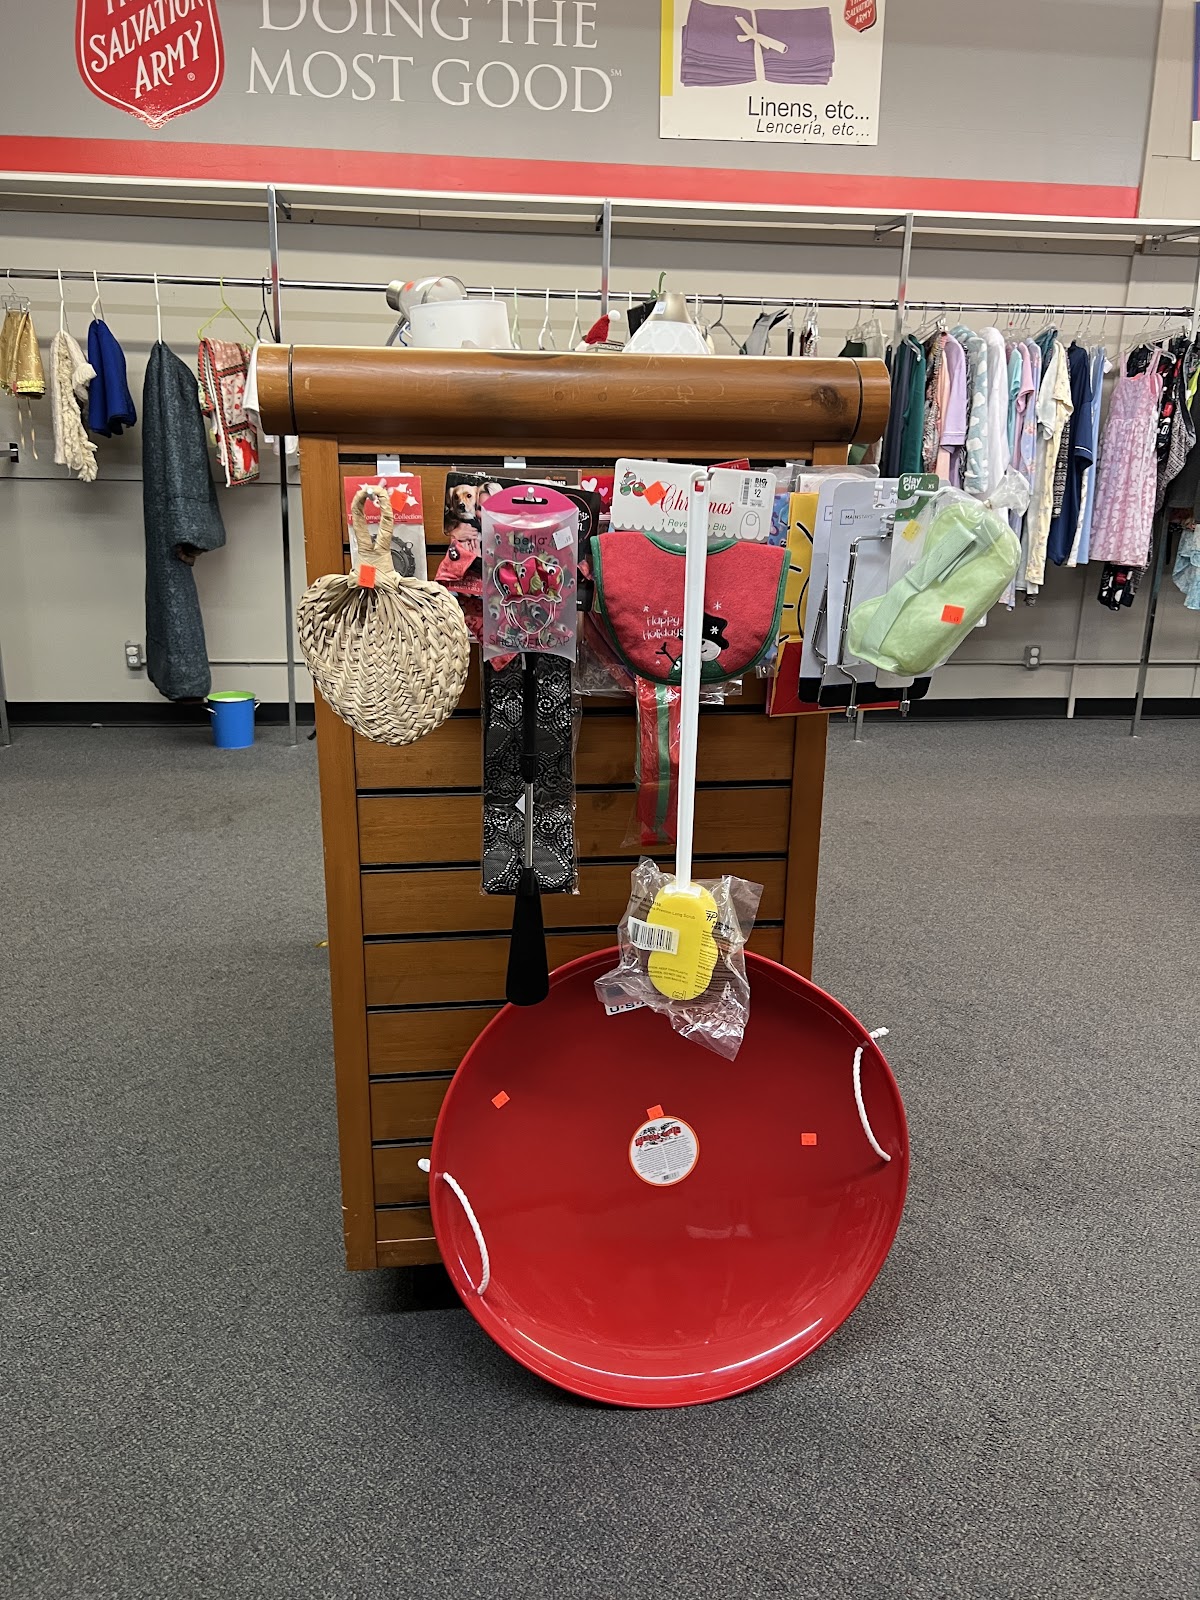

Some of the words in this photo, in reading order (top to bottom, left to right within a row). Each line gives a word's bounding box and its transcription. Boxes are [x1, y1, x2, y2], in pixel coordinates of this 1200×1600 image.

[854, 8, 872, 25] ARMY
[259, 0, 473, 41] DOING
[487, 0, 598, 49] THE
[135, 20, 203, 99] ARMY
[245, 47, 414, 102] MOST
[432, 58, 613, 113] GOOD
[748, 96, 818, 121] Linens,
[825, 100, 870, 120] etc...
[756, 119, 825, 137] Lencería,
[832, 122, 870, 137] etc...
[903, 475, 922, 489] Play
[903, 482, 916, 491] On
[754, 489, 762, 498] $2
[661, 518, 665, 526] 1
[713, 523, 727, 532] Bib
[514, 534, 545, 545] bella
[647, 616, 680, 628] Happy
[546, 635, 570, 648] CAP
